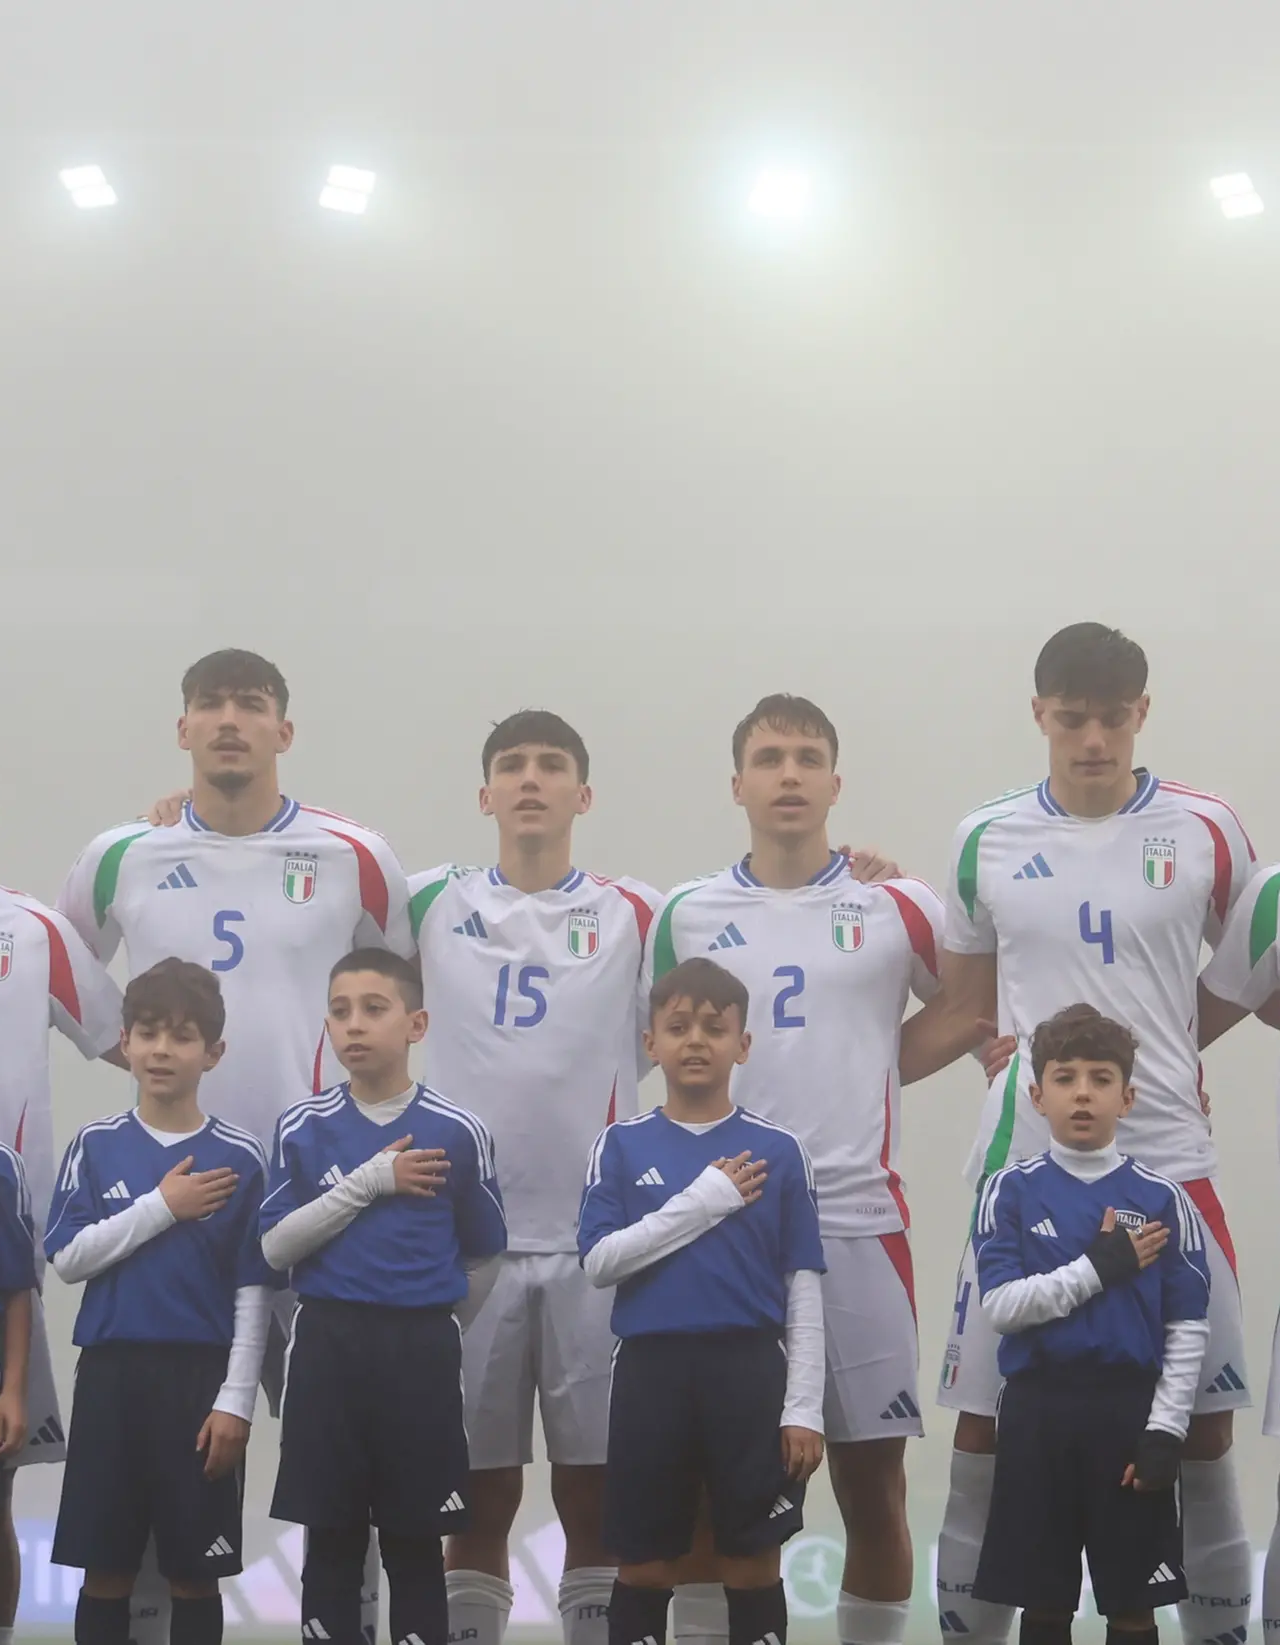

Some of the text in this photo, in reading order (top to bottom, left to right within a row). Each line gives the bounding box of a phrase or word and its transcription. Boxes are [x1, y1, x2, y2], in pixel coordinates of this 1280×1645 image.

[1145, 846, 1173, 857] ITALIA
[287, 859, 314, 872] ITALIA
[571, 917, 596, 928] ITALIA
[834, 911, 860, 922] ITALIA
[1078, 901, 1116, 964] 4
[211, 910, 246, 971] 5
[494, 963, 550, 1028] 15
[772, 965, 806, 1028] 2
[1116, 1212, 1143, 1226] ITALIA
